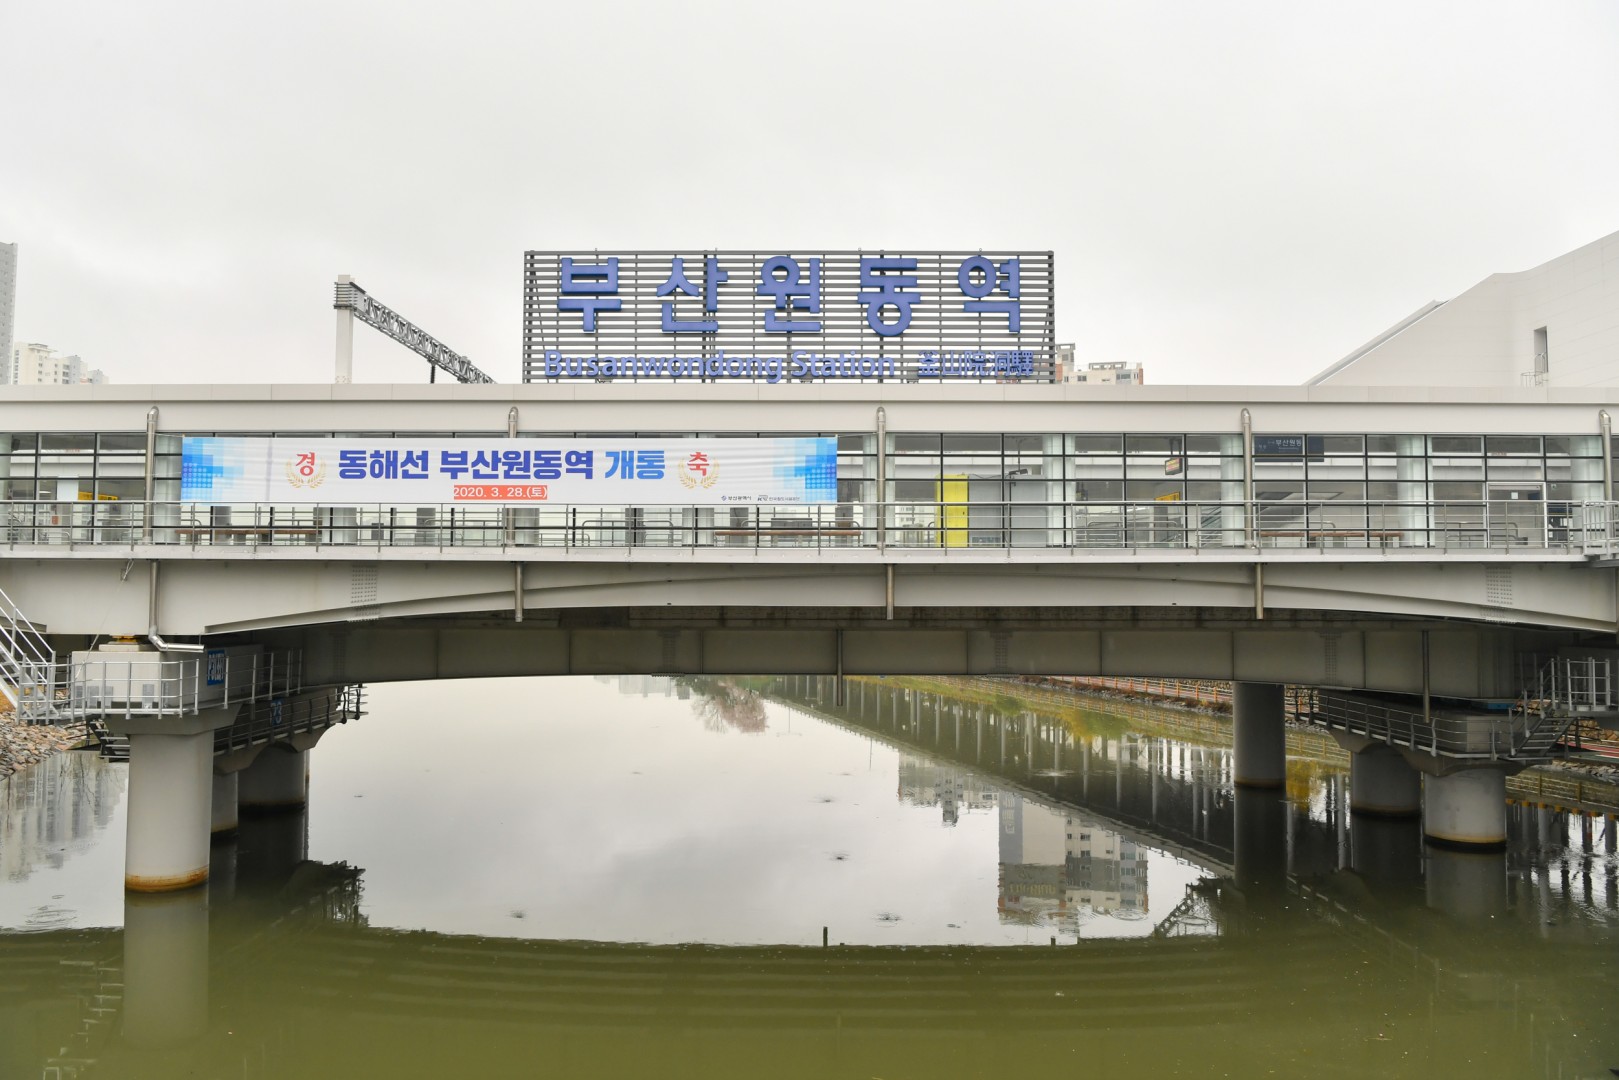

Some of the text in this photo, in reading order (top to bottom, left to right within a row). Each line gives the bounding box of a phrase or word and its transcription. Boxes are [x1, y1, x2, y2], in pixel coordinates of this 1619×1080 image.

[556, 255, 1021, 337] 부산원동역
[544, 350, 895, 384] Busanwondong Station
[295, 452, 316, 477] 경
[339, 450, 666, 480] 동해선 부산원동역 개통
[687, 451, 710, 477] 축
[454, 487, 547, 498] 2020. 3. 28.(토)
